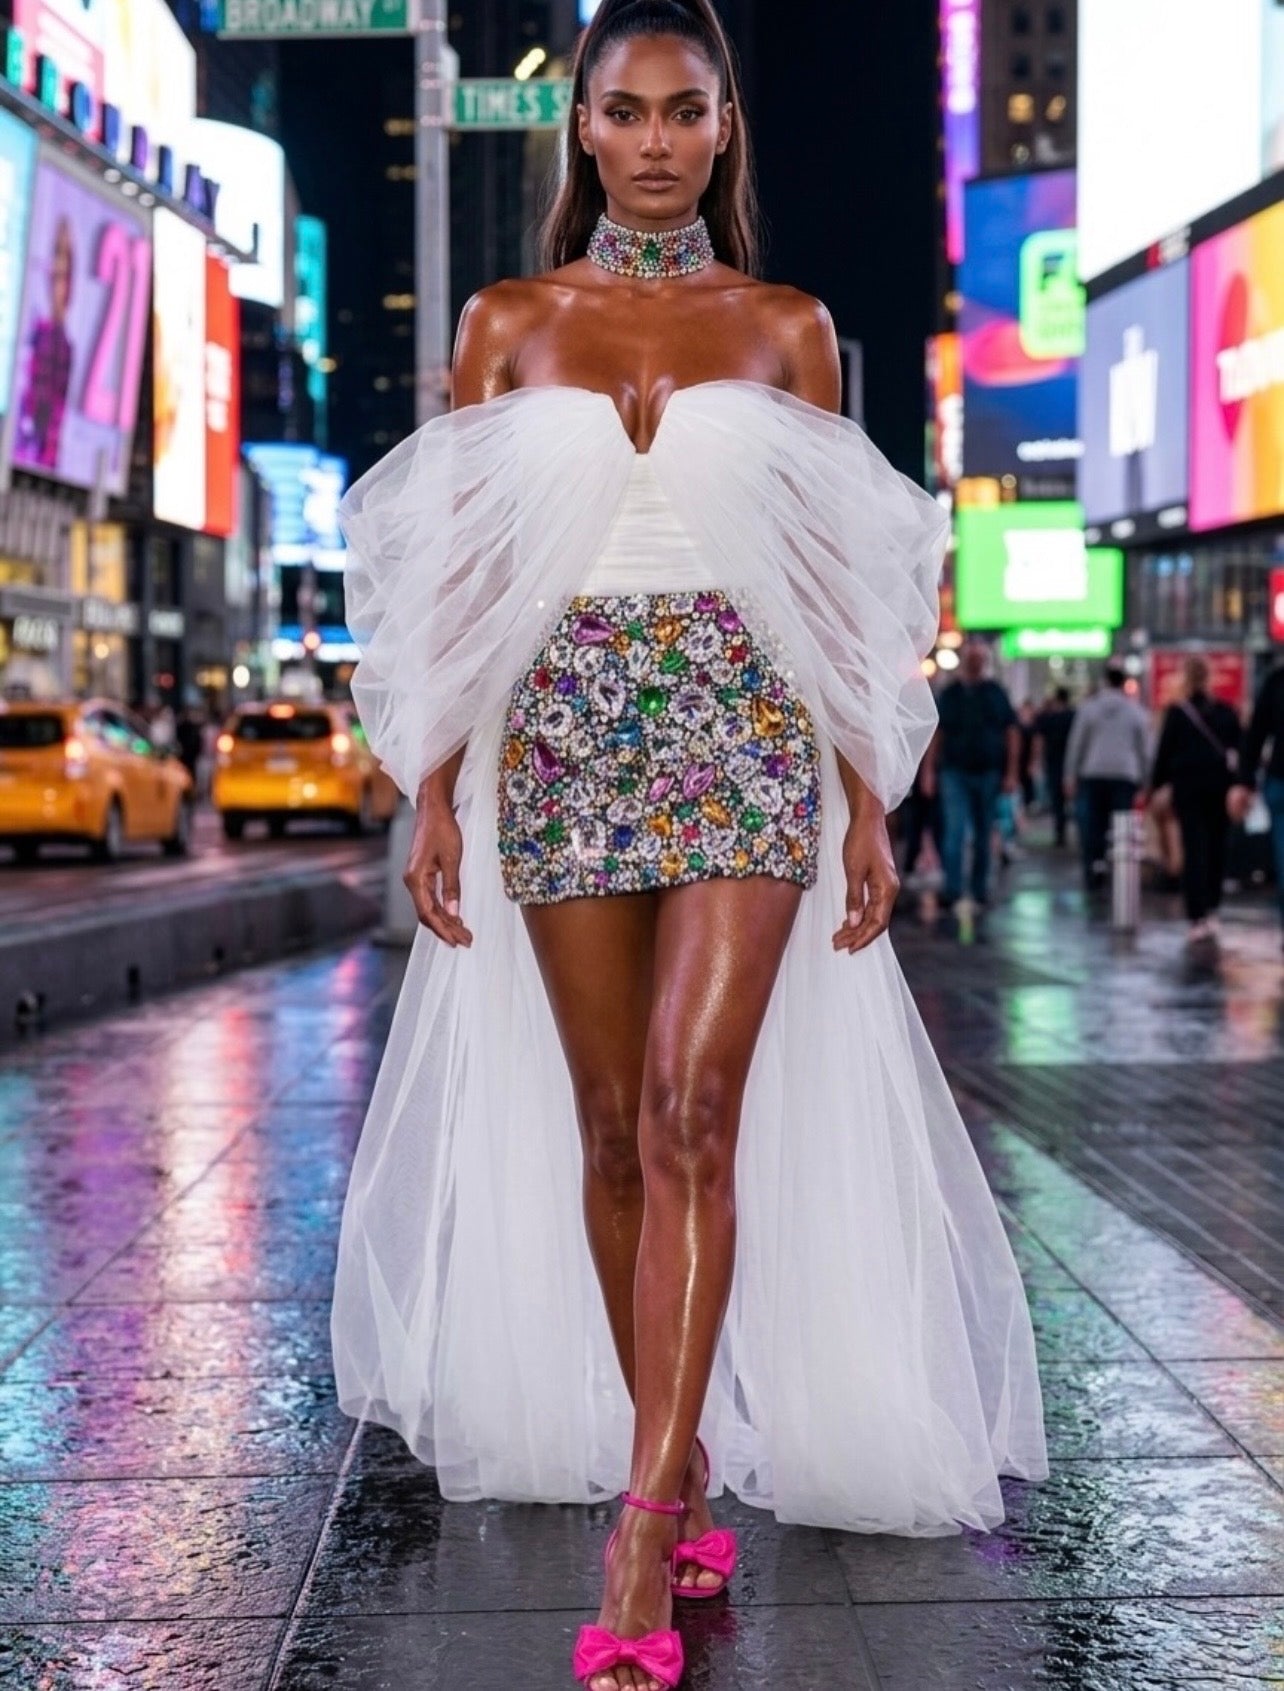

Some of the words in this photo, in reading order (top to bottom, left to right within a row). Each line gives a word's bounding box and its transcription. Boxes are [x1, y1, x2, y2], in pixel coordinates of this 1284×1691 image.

[226, 0, 373, 31] BROADWAY
[462, 85, 541, 121] TIMES
[551, 84, 574, 121] S
